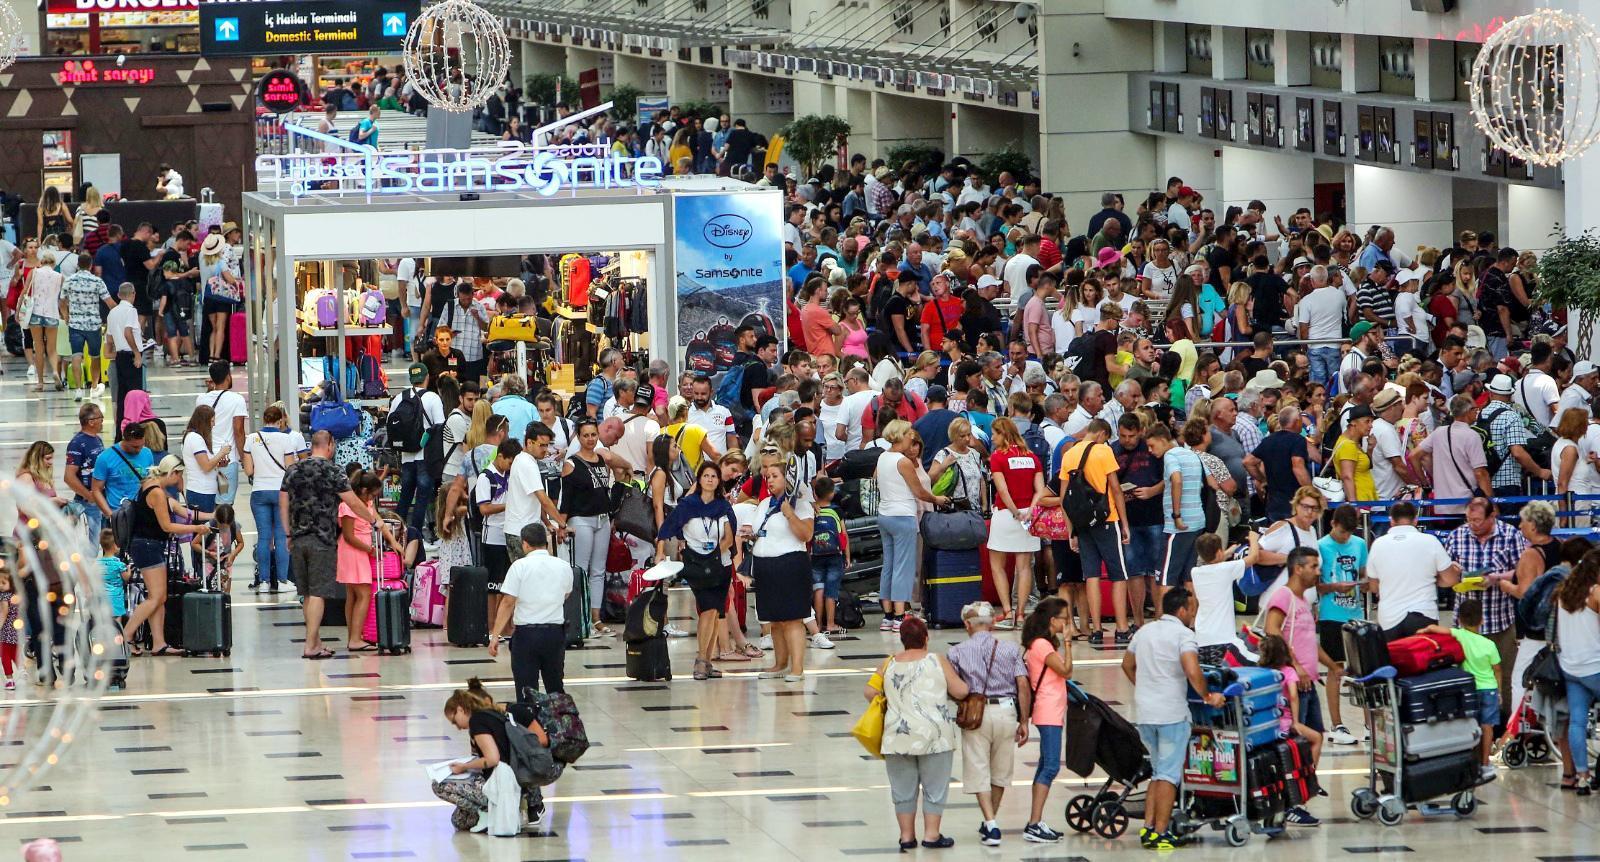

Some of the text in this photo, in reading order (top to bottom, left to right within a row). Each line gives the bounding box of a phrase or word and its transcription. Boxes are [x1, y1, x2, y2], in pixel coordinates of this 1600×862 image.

[264, 11, 357, 28] İç Hatlar Terminali
[265, 28, 357, 43] Domestic Terminal
[380, 151, 662, 196] Samsonite
[724, 253, 733, 261] by
[695, 267, 763, 279] Samsonite
[1190, 744, 1213, 762] Have
